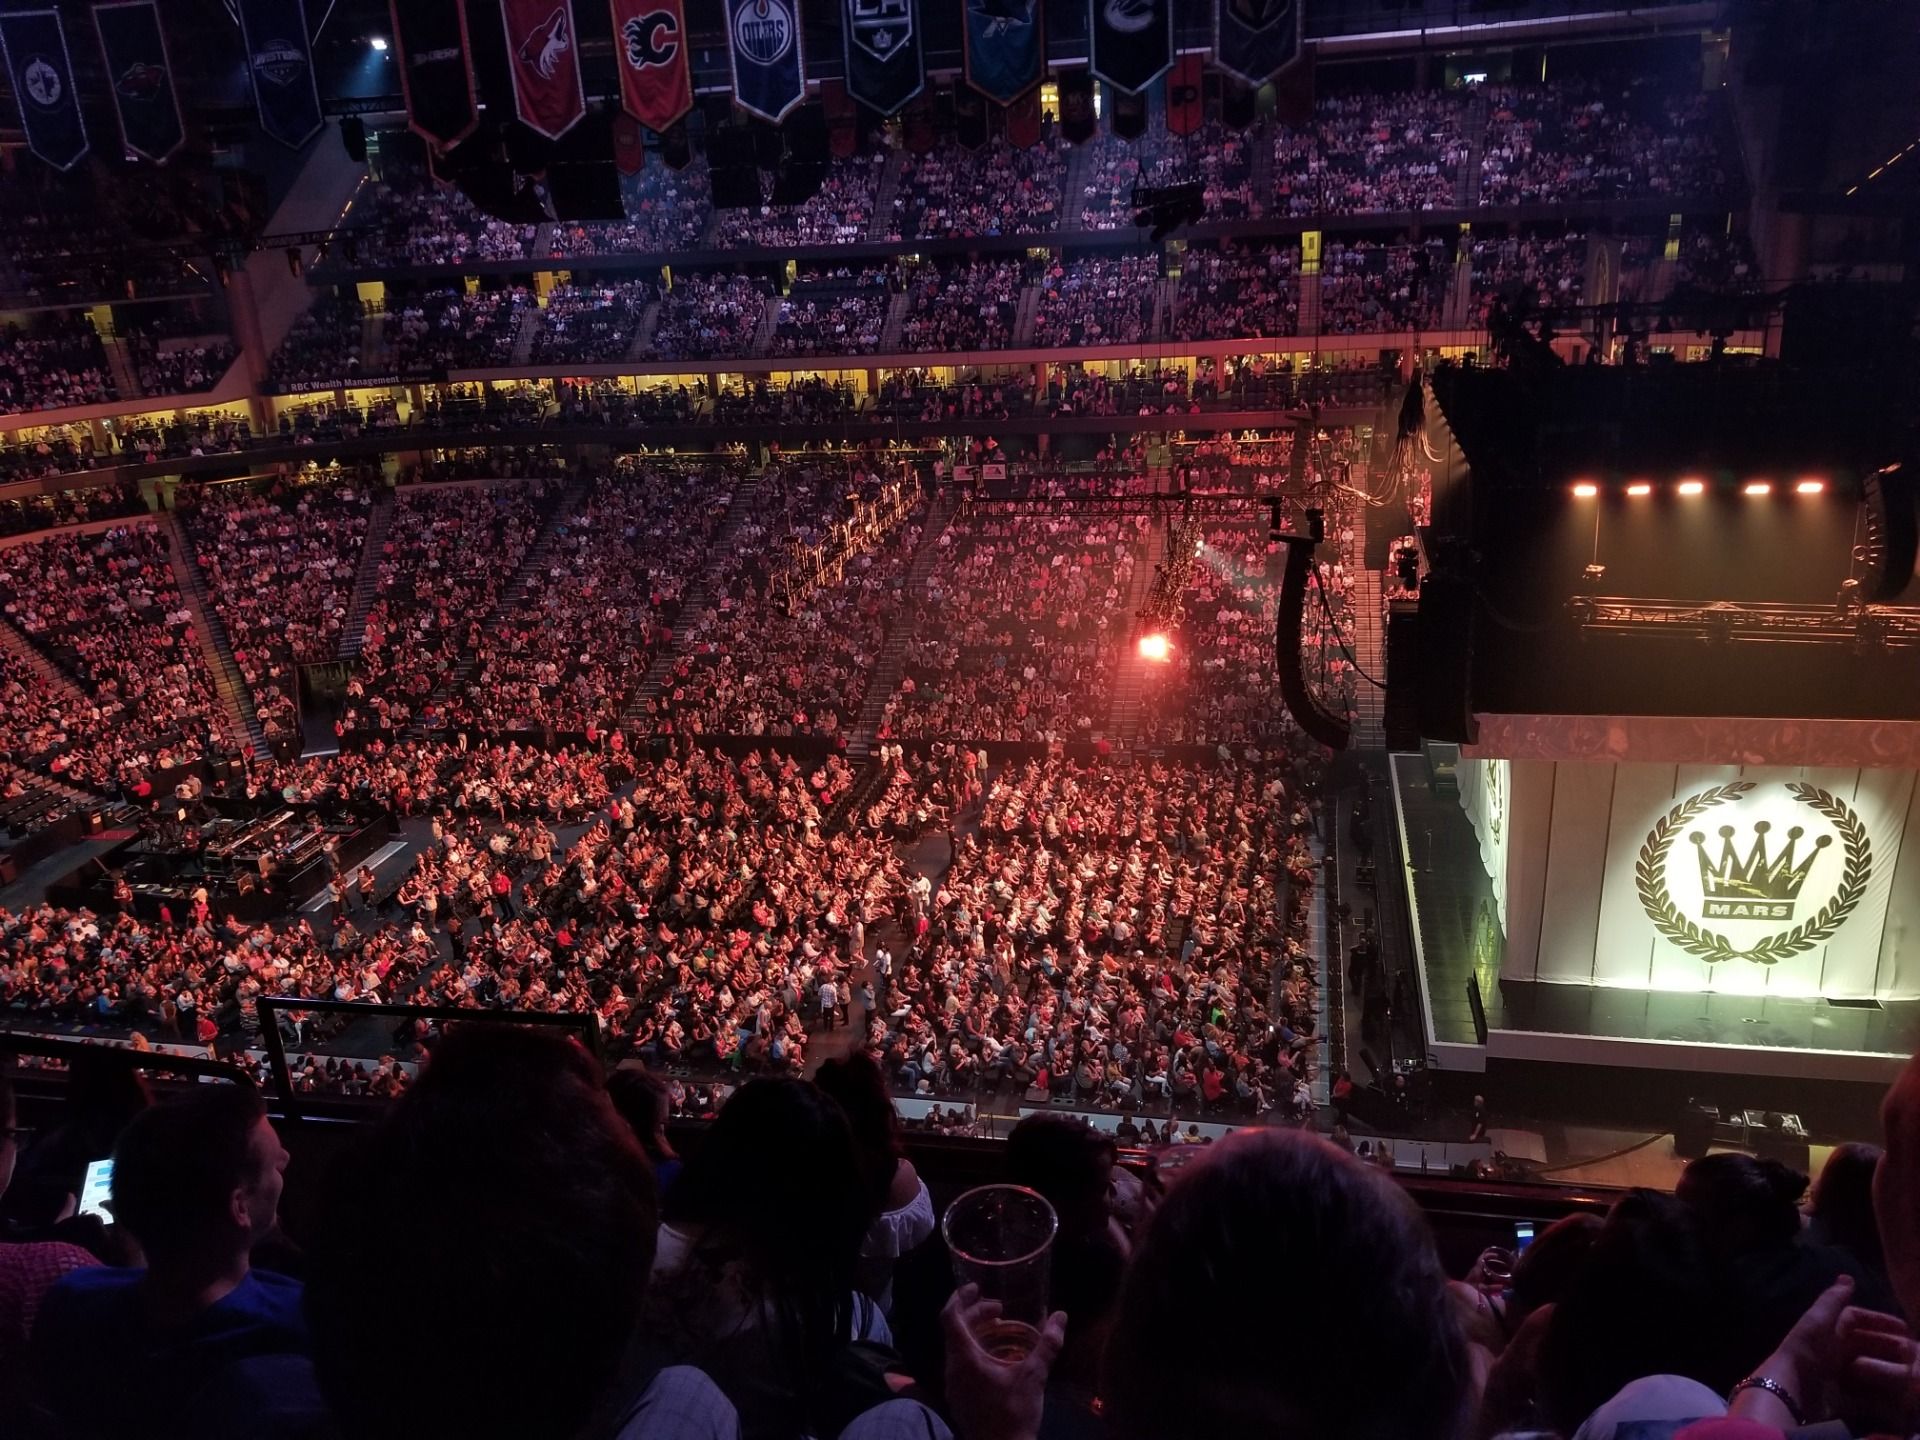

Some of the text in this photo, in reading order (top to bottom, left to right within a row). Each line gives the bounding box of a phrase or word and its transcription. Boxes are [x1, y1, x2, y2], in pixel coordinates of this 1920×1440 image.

[742, 19, 784, 59] OILERS
[290, 382, 310, 392] RBC
[310, 379, 342, 390] Wealth
[344, 375, 400, 387] Management
[1708, 903, 1788, 917] MARS
